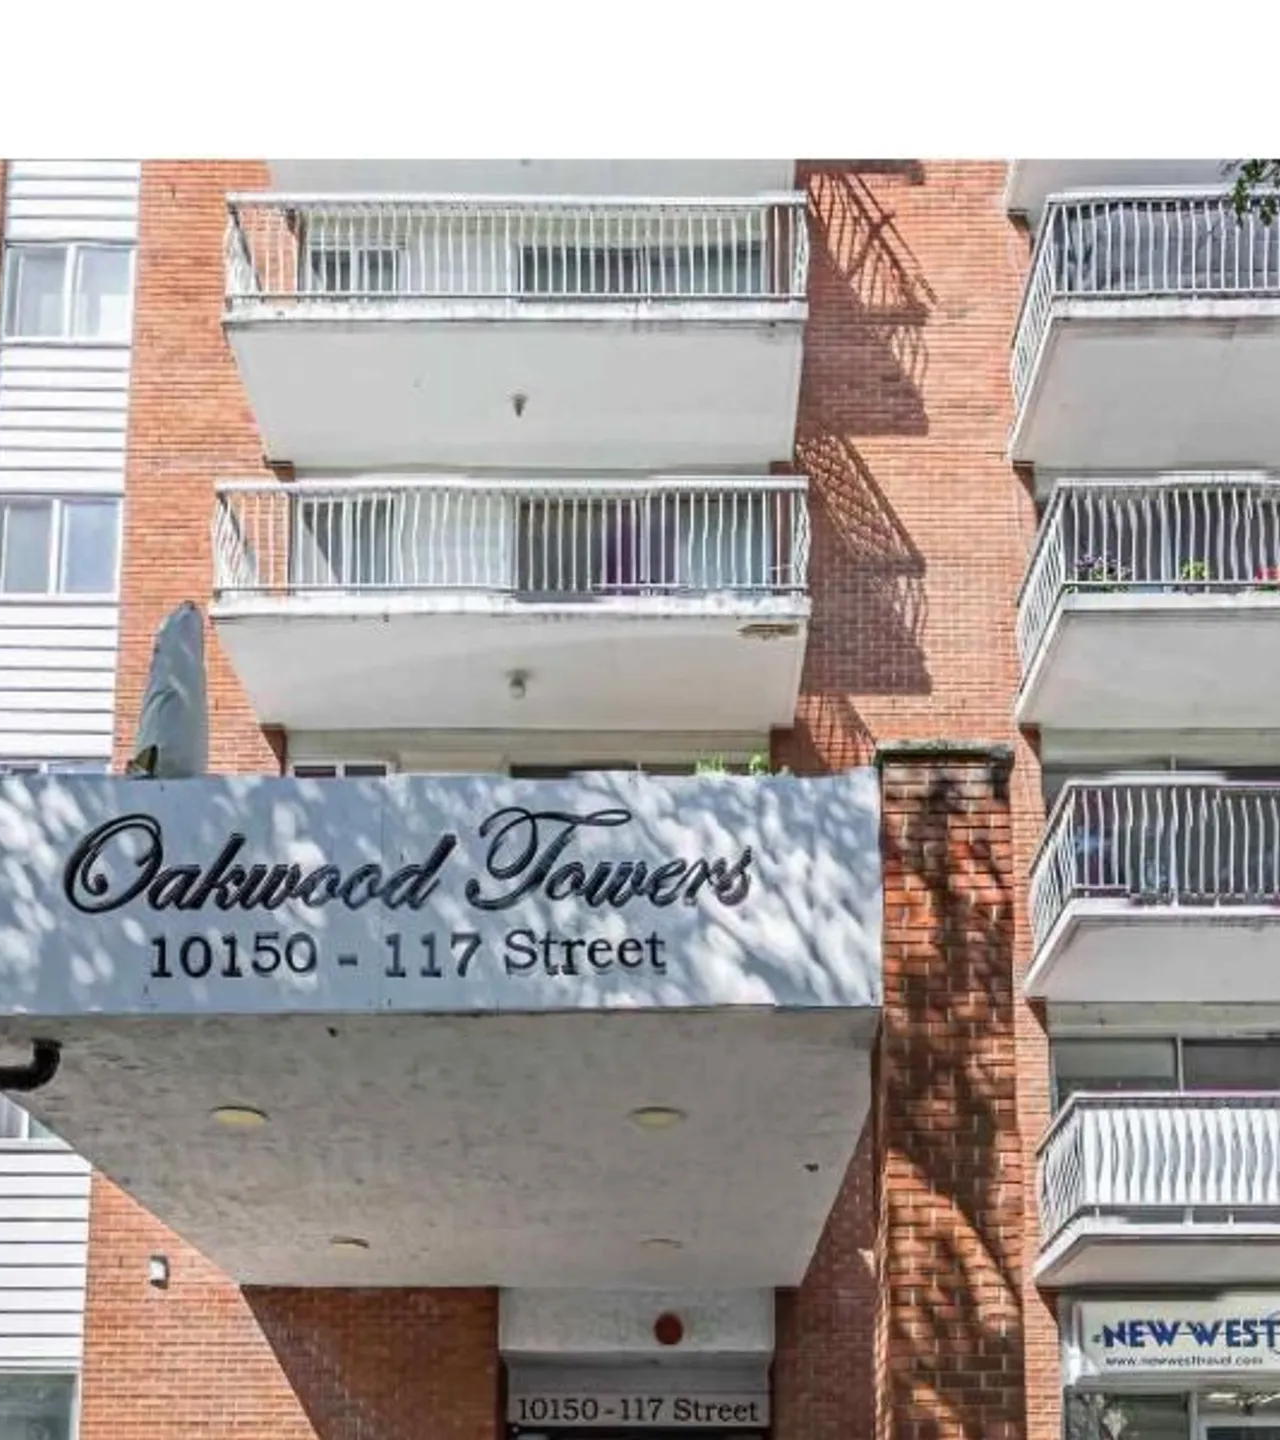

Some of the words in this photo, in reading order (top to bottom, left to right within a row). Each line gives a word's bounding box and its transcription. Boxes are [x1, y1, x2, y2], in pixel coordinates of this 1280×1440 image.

[63, 811, 458, 914] Oakwood
[466, 806, 754, 912] Towers
[149, 932, 318, 979] 10150
[384, 931, 482, 979] 117
[504, 929, 667, 976] Street
[1102, 1319, 1180, 1348] NEW
[1106, 1354, 1263, 1368] www.newwesttravel.com
[673, 1398, 759, 1422] Street
